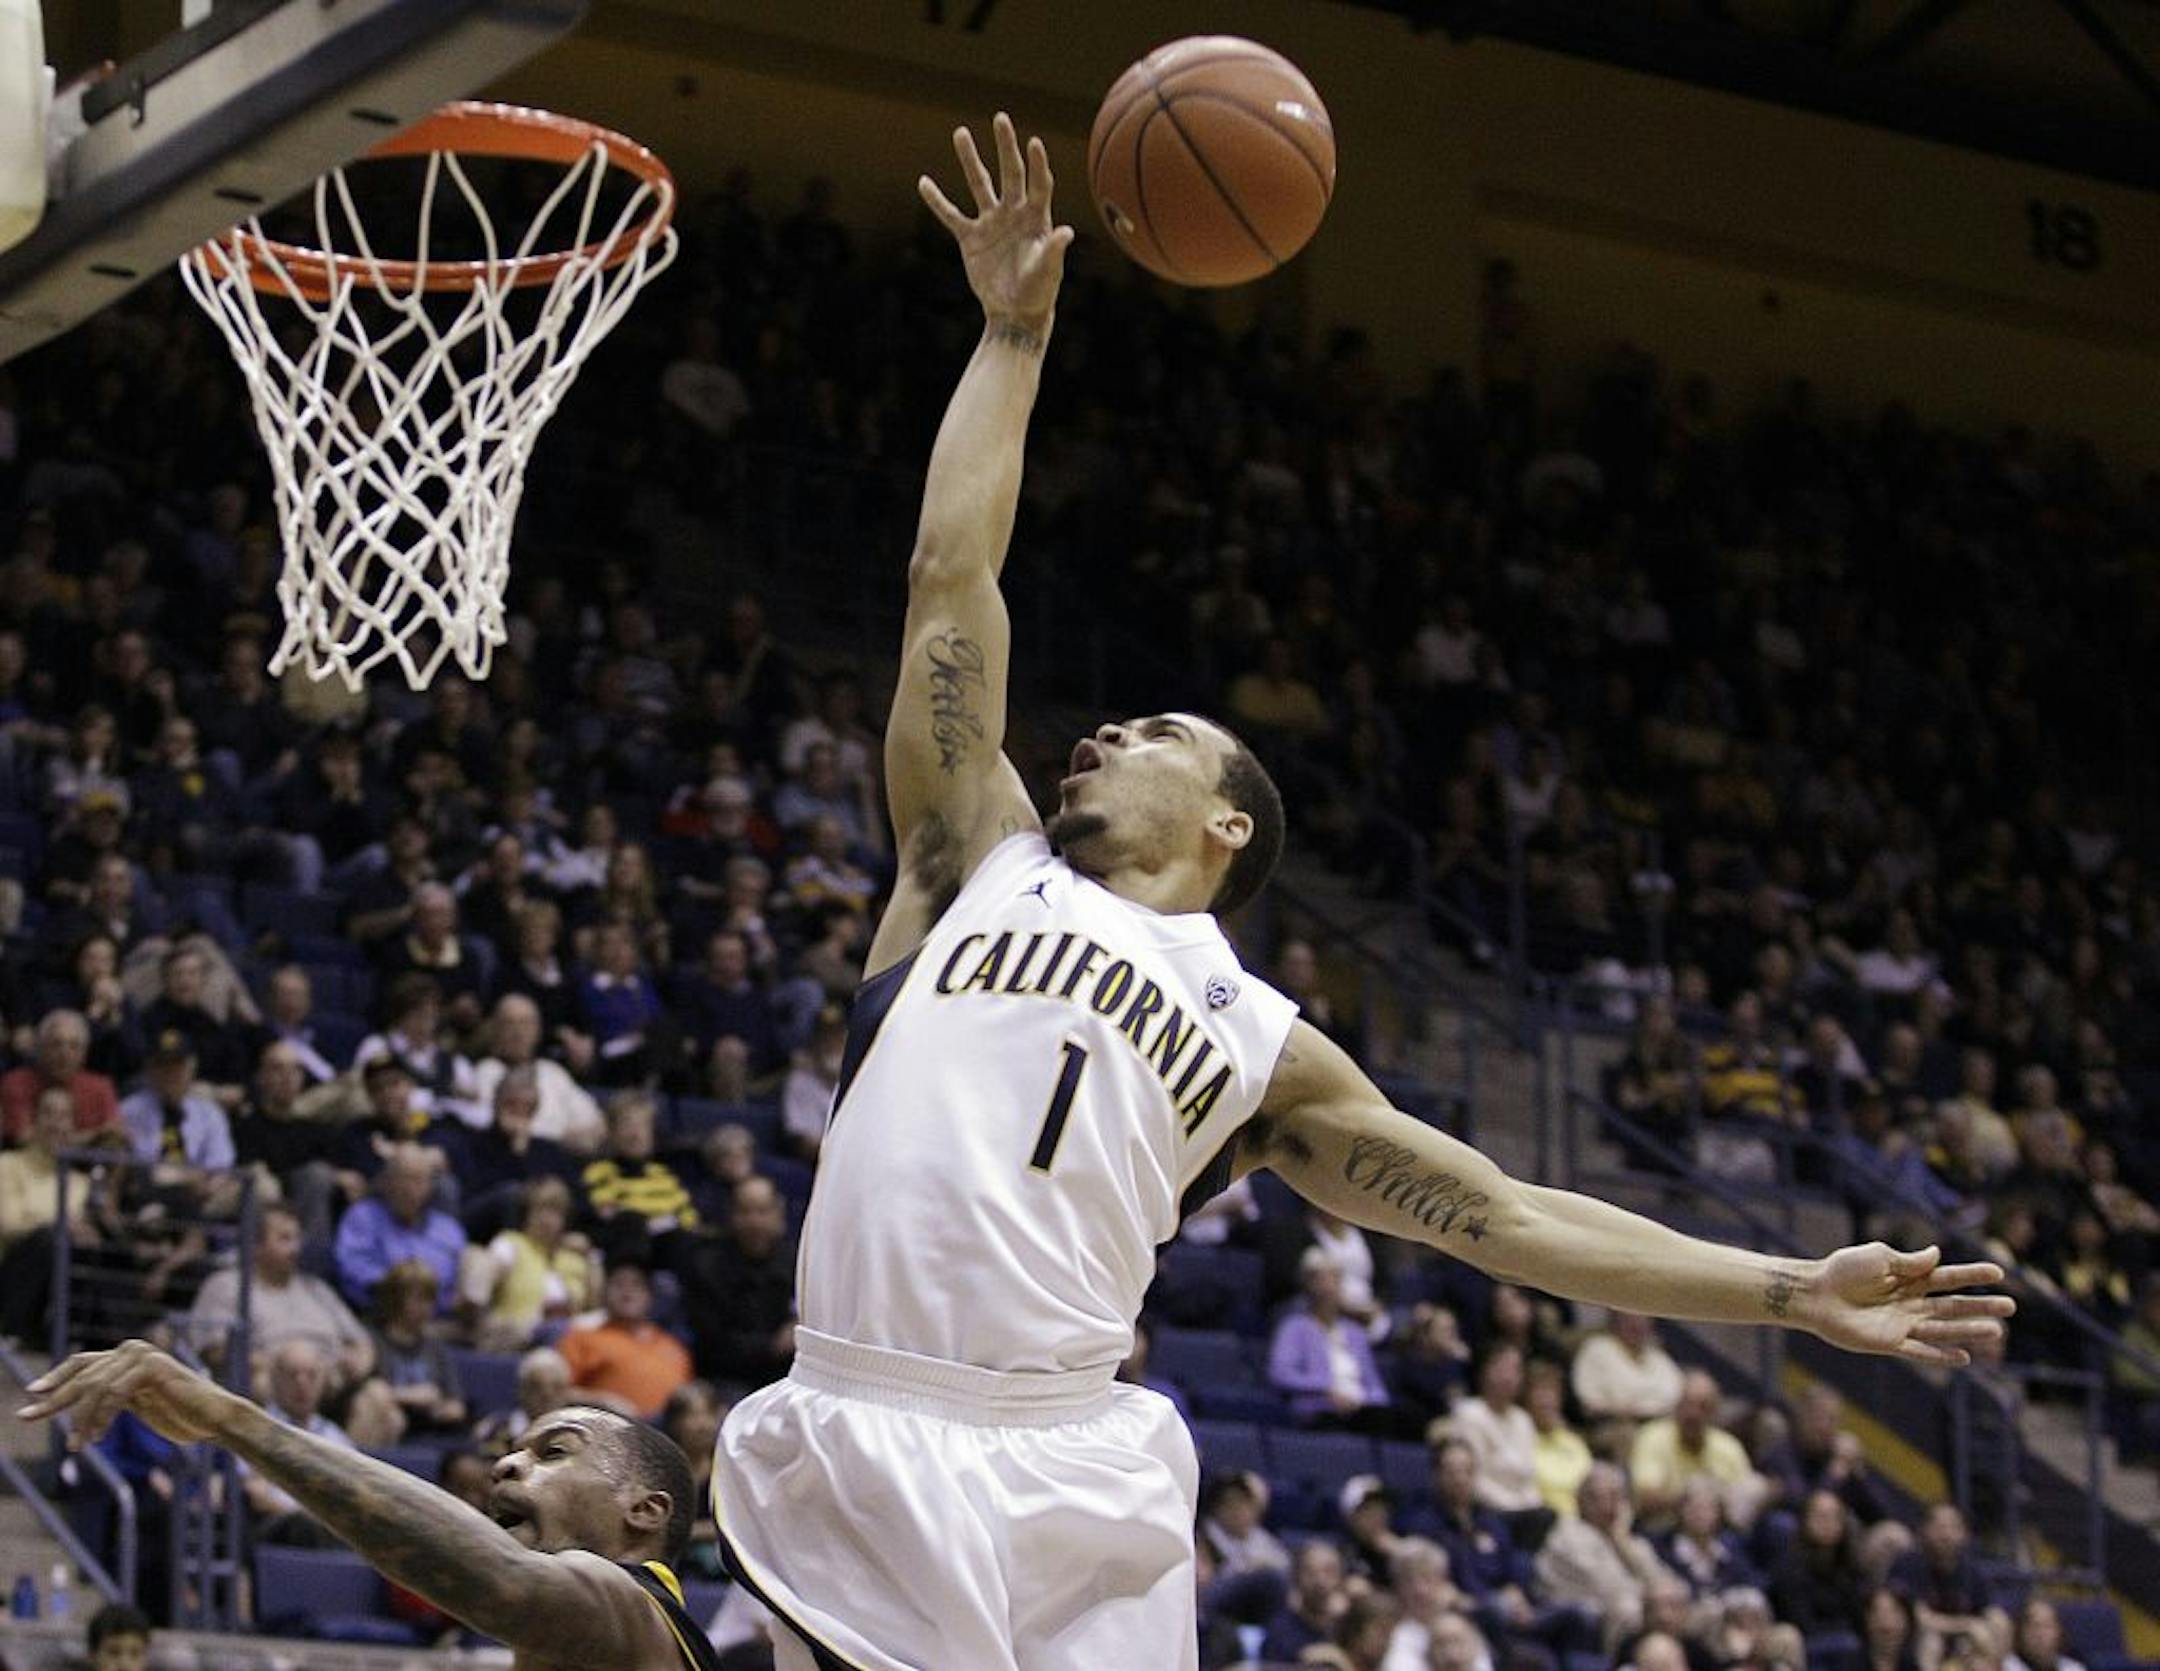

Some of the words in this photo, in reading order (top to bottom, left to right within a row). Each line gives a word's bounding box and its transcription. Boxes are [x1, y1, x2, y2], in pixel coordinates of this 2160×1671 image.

[2026, 198, 2100, 270] 18
[935, 930, 1233, 1142] CALIFORNIA
[1028, 1037, 1089, 1173] 1
